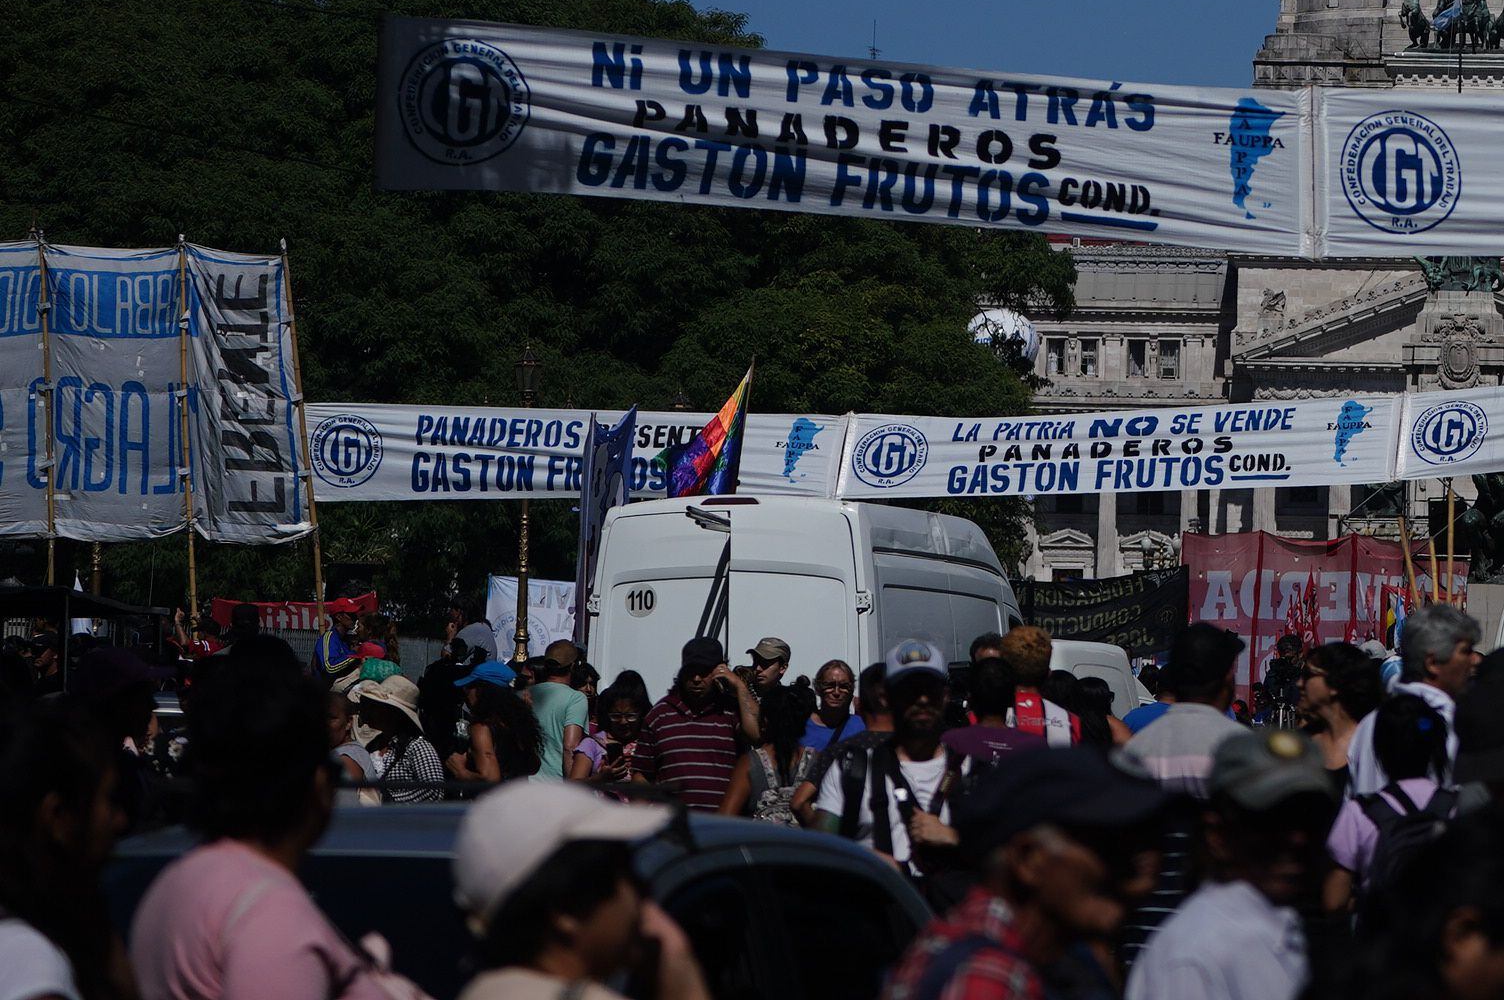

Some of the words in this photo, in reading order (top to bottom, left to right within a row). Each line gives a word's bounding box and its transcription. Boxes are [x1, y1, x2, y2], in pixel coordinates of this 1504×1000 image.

[678, 49, 751, 98] UN
[786, 60, 934, 113] PASO
[968, 80, 1155, 132] ATRÁS
[632, 100, 1062, 170] PANADEROS
[1213, 132, 1285, 149] FAUPPA
[576, 132, 807, 202] GASTON
[830, 152, 1050, 226] FRUTOS
[1058, 178, 1160, 217] COND.
[415, 415, 583, 449] PANADEROS
[952, 423, 981, 442] LA
[1089, 416, 1158, 439] NO
[1170, 413, 1202, 434] SE
[1214, 408, 1296, 432] VENDE
[1327, 420, 1372, 431] FAUPPA
[774, 440, 820, 450] FAUPPA
[979, 437, 1233, 462] PANADEROS
[411, 451, 534, 492] GASTON
[546, 456, 667, 491] FROS
[947, 462, 1079, 494] GASTON
[1095, 455, 1225, 490] FRUTOS
[1229, 454, 1292, 472] COND.
[627, 589, 654, 611] 110
